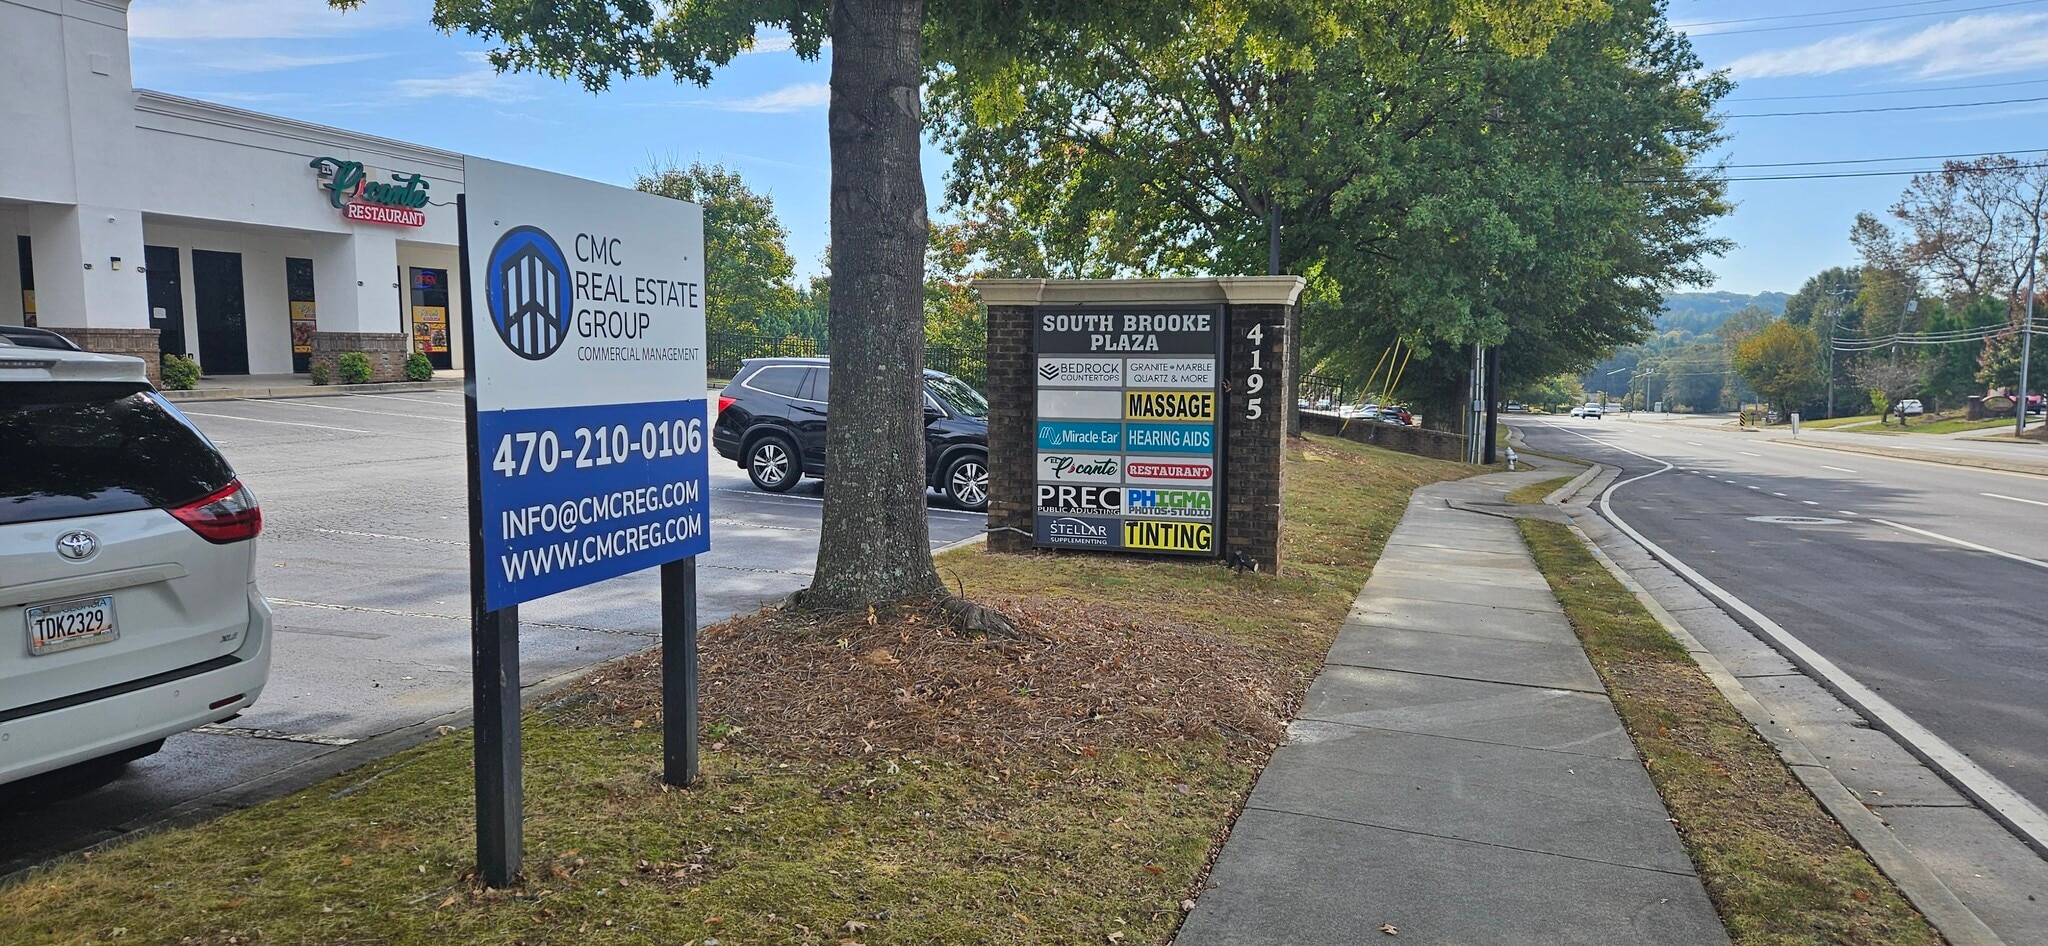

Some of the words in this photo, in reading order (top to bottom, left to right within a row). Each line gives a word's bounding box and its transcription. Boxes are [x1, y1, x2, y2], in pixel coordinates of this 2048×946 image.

[321, 165, 331, 175] EL
[348, 204, 424, 226] RESTAURANT
[575, 233, 622, 266] CMC
[575, 271, 630, 303] REAL
[635, 276, 698, 308] ESTATE
[577, 309, 650, 339] GROUP
[1042, 314, 1114, 332] SOUTH
[1123, 314, 1211, 332] BROOKE
[1090, 334, 1159, 351] PLAZA
[578, 346, 641, 361] COMMERCIAL
[642, 347, 699, 361] MANAGEMENT
[1061, 363, 1120, 374] BEDROCK
[1130, 363, 1168, 371] GRANITE
[1176, 363, 1212, 371] MARBLE
[1246, 323, 1264, 420] 4195
[1061, 374, 1120, 382] COUNTERTOPS
[1133, 374, 1168, 383] QUARTZ
[1170, 375, 1178, 383] &
[1181, 375, 1208, 383] MORE
[1129, 394, 1211, 418] MASSAGE
[1129, 430, 1180, 446] HEARING
[1182, 431, 1210, 447] AIDS
[492, 418, 702, 478] 470-210-0106
[1129, 464, 1210, 477] RESTAURANT
[1037, 485, 1120, 510] PREC
[1128, 489, 1211, 508] PHIGMA
[502, 479, 699, 540] INFO@CMCREG.COM
[1069, 507, 1120, 516] ADJUSTING
[1050, 523, 1107, 536] STELLAR
[1125, 521, 1211, 550] TINTING
[501, 512, 702, 583] WWW.CMCREG.COM
[1050, 537, 1108, 545] SUPPLEMENTING
[36, 609, 104, 641] TDK2329
